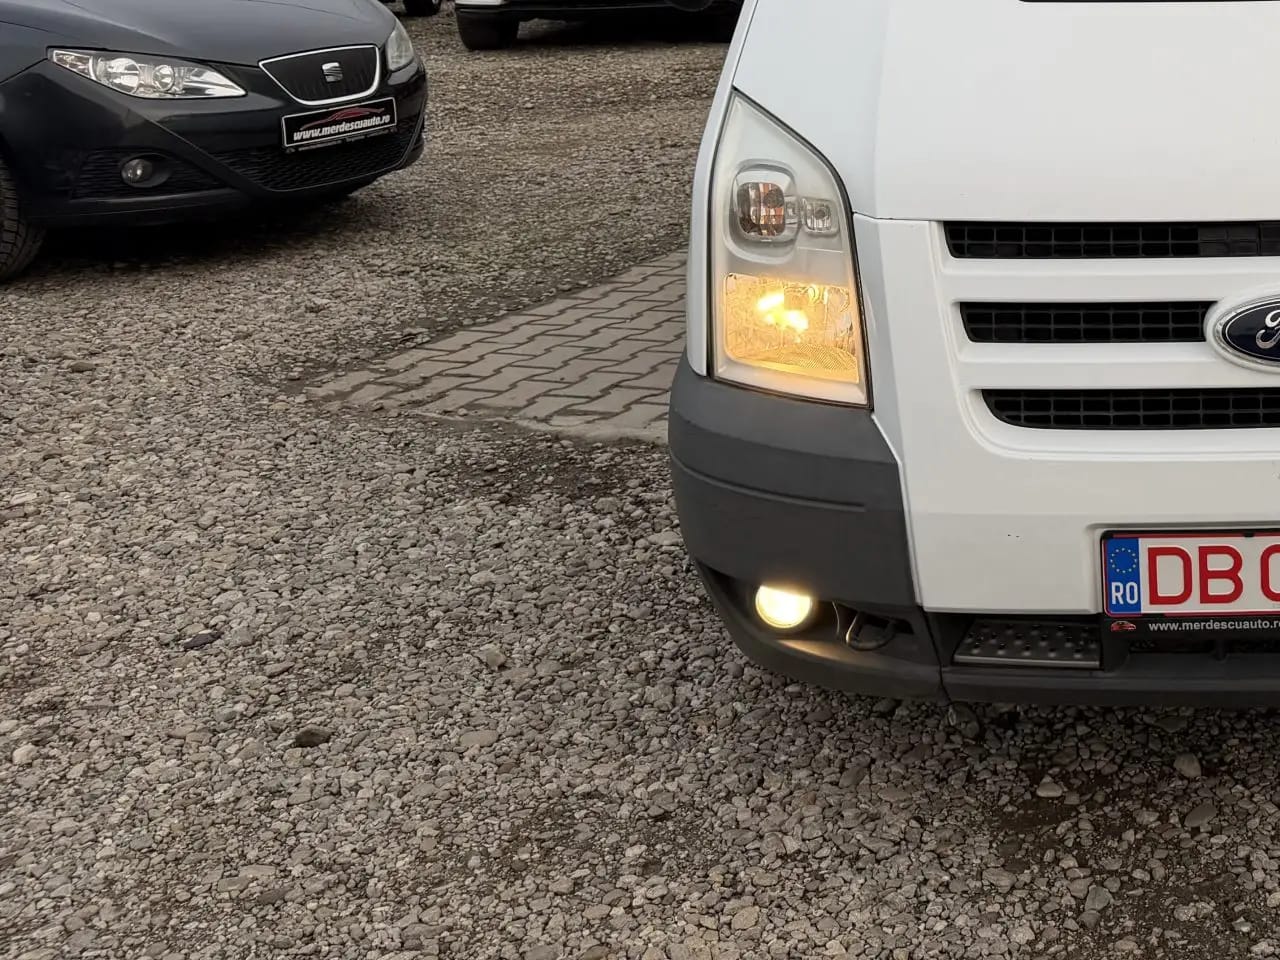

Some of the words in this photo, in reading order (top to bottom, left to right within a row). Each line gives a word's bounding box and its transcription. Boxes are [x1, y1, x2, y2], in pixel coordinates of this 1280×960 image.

[293, 114, 391, 141] www.merdescuauto.ro
[1110, 581, 1138, 606] RO
[1147, 545, 1243, 606] DB
